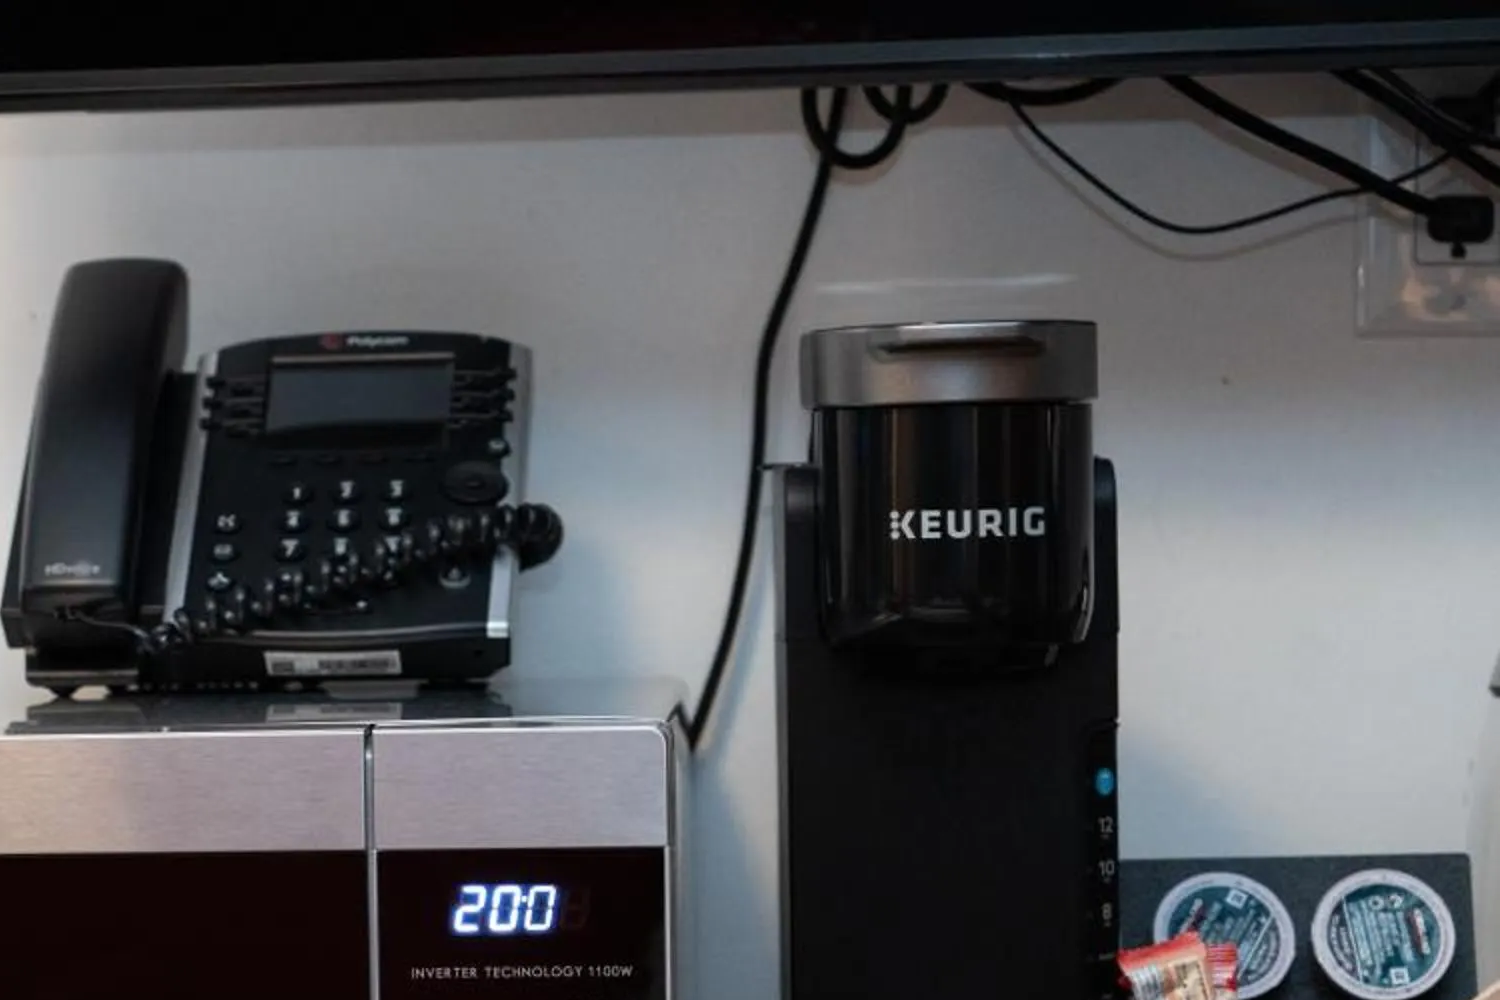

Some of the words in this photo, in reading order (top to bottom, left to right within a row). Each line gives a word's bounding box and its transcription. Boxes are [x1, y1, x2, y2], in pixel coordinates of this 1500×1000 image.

[889, 506, 1046, 540] KEURIG
[1098, 816, 1114, 833] 12
[1098, 860, 1115, 876] 10
[411, 967, 478, 979] INVERTER
[485, 966, 583, 979] TECHNOLOGY
[588, 965, 634, 978] 1100W
